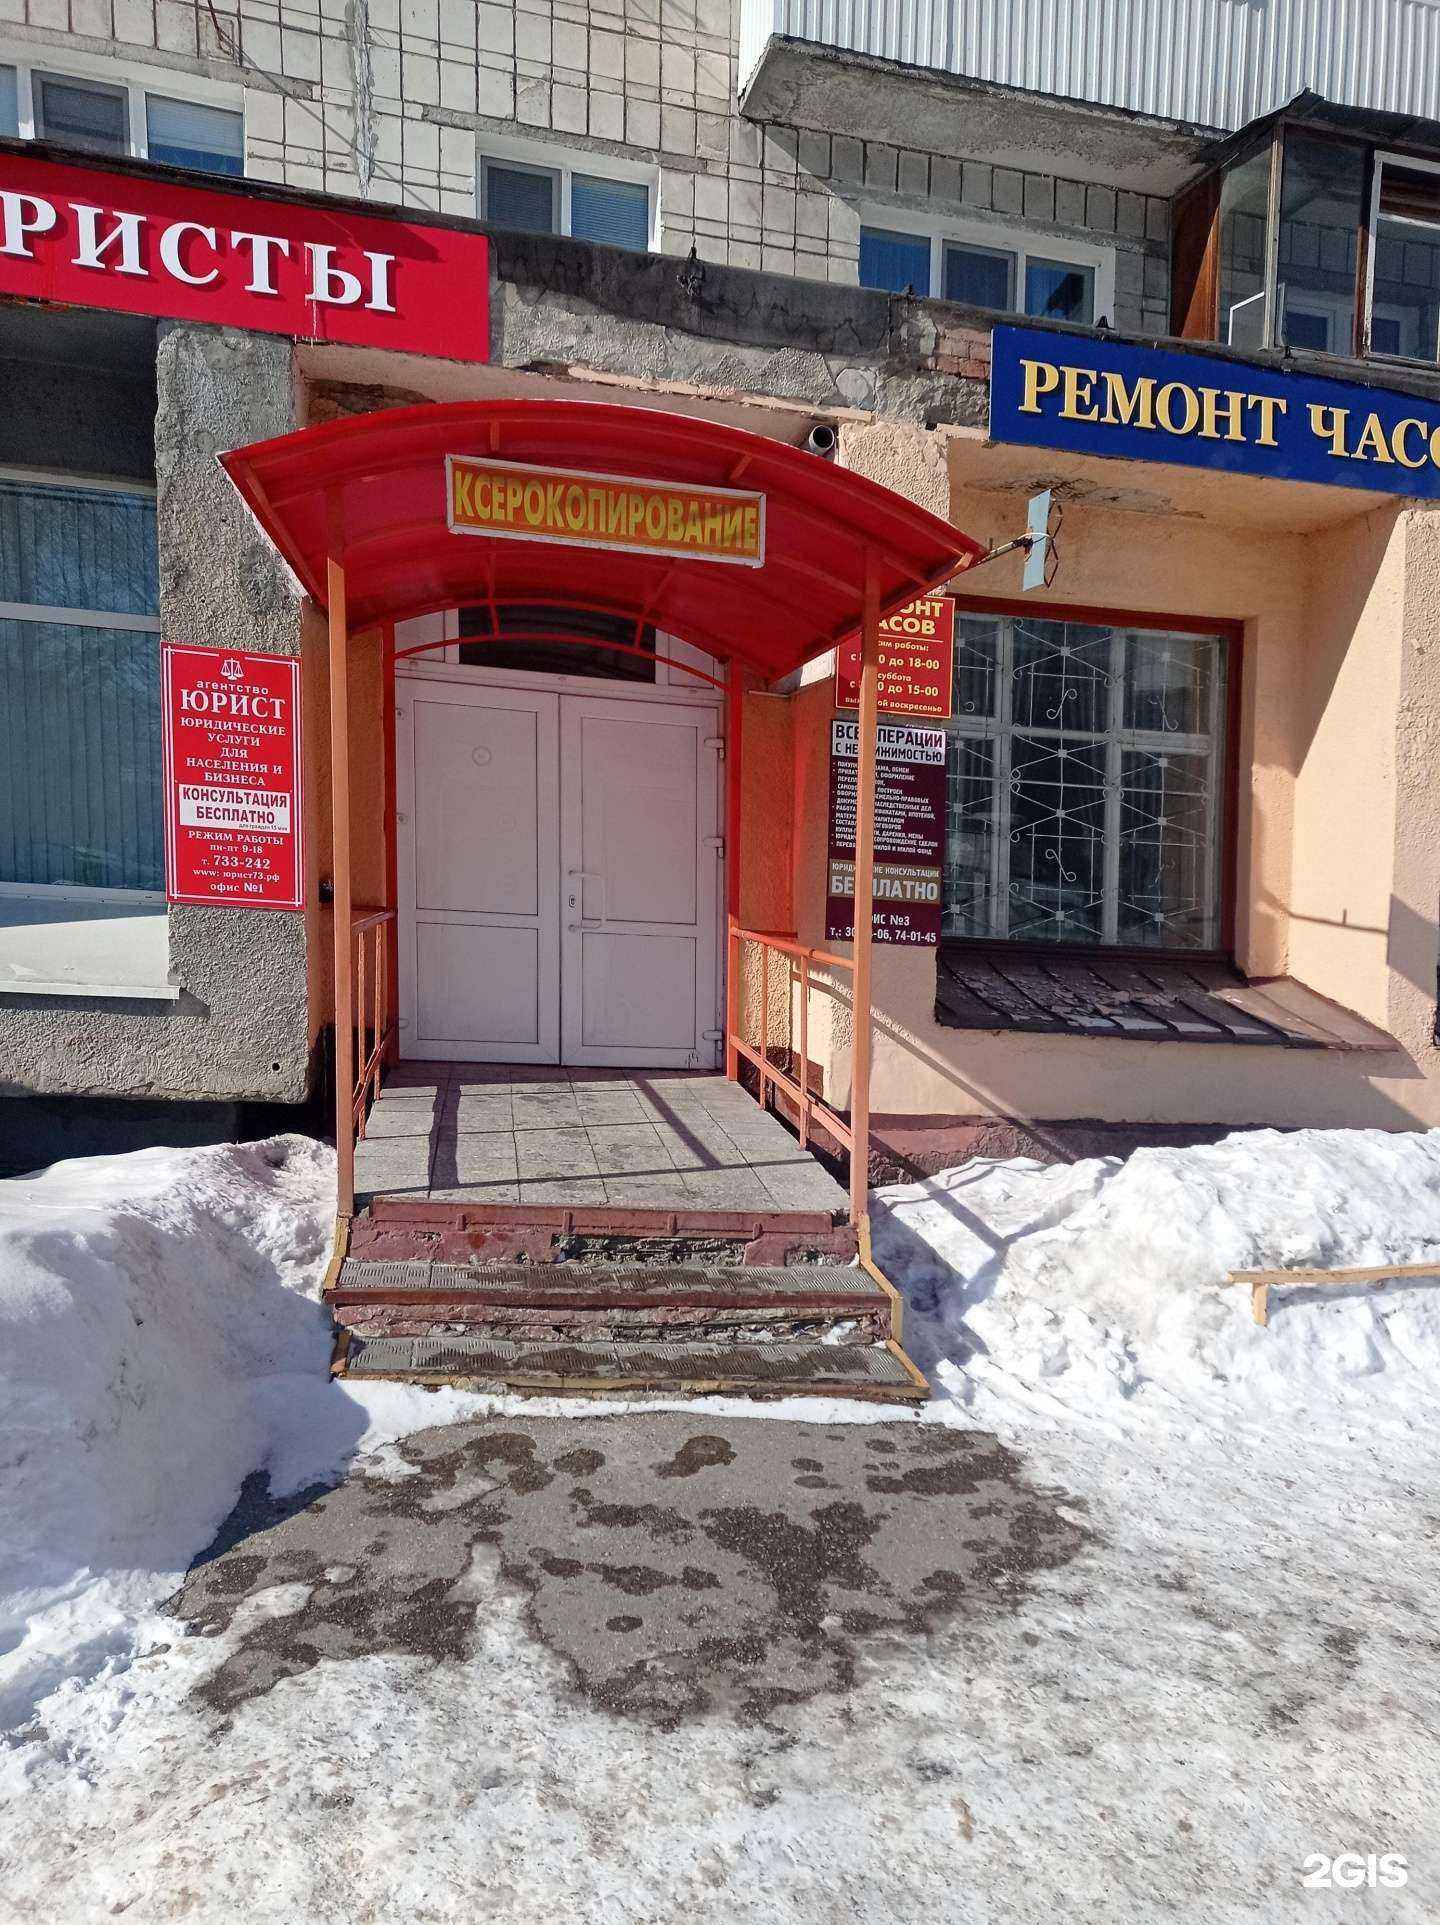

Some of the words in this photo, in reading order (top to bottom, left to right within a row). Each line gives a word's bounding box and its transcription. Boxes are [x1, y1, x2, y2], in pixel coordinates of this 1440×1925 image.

[0, 190, 396, 313] РИСТЫ
[1018, 359, 1287, 447] РЕМОНТ
[1306, 403, 1440, 469] ЧАС
[455, 471, 758, 549] КСЕРОКОПИРОВАНИЕ
[889, 657, 904, 667] до
[909, 658, 940, 670] 18-00
[877, 672, 912, 682] суббота
[196, 680, 269, 695] агентство
[888, 685, 903, 694] до
[908, 684, 939, 697] 15-00
[180, 688, 286, 720] ЮРИСТ
[180, 717, 287, 736] ЮРИДИЧЕСКИЕ
[207, 732, 261, 747] УСЛУГИ
[836, 725, 859, 740] ВСЕ
[877, 728, 942, 748] ПЕРАЦИИ
[220, 747, 249, 759] ДЛЯ
[186, 757, 268, 774] НАСЕЛЕНИЯ
[272, 765, 283, 775] И
[204, 772, 266, 786] БИЗНЕСА
[182, 786, 288, 809] КОНСУЛЬТАЦИЯ
[195, 805, 275, 825] БЕСПЛАТНО
[188, 831, 233, 842] РЕЖИМ
[237, 833, 284, 846] РАБОТЫ
[210, 844, 239, 852] пн-пт
[242, 844, 263, 854] 9-18
[201, 858, 210, 866] т.
[213, 854, 271, 869] 733-242
[192, 868, 220, 877] www:
[223, 871, 280, 883] юрист73.рф
[210, 883, 240, 893] офис
[244, 882, 263, 893] №1
[890, 915, 910, 926] №3
[895, 929, 937, 943] 74-01-45
